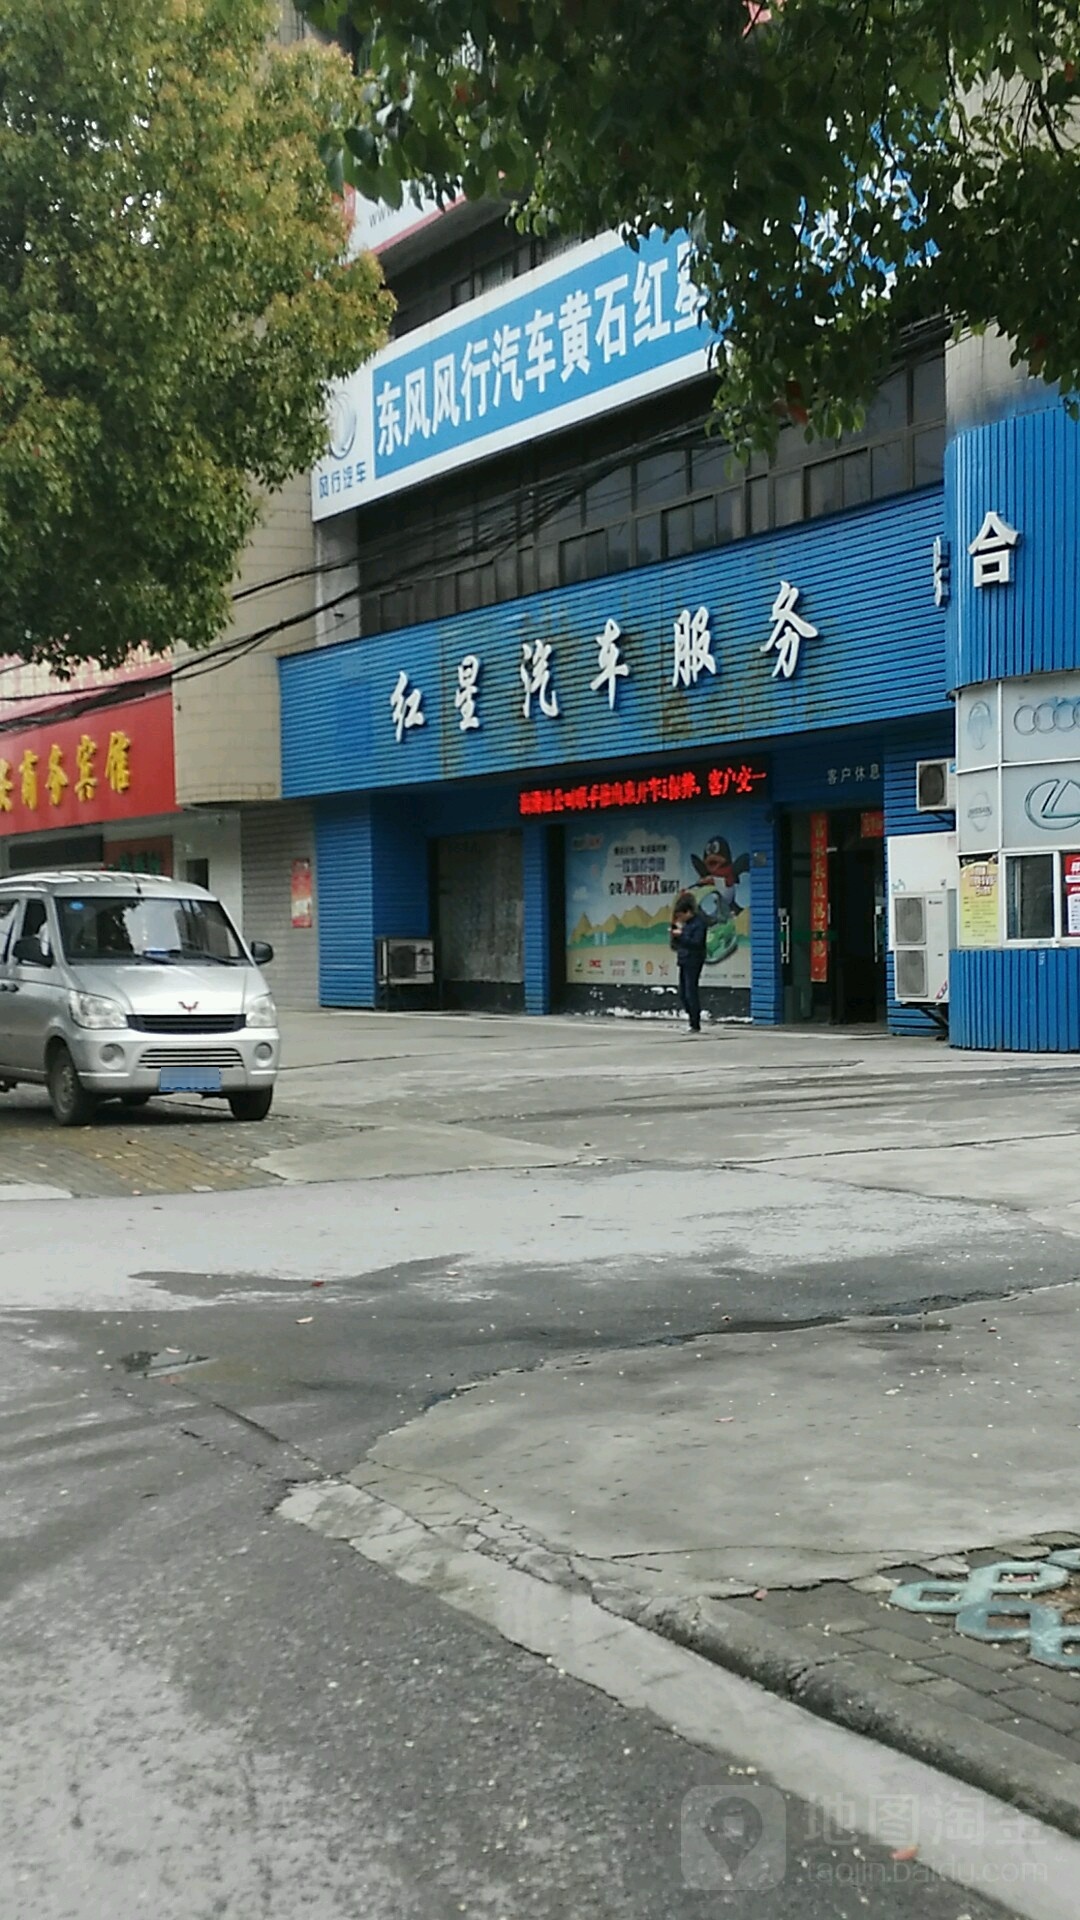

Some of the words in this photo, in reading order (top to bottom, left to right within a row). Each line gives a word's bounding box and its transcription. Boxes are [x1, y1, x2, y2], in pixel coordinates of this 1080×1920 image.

[318, 461, 366, 500] 风行汽车
[969, 511, 1019, 588] 合
[389, 580, 819, 743] 红星汽车服务
[827, 763, 881, 785] 客户休息
